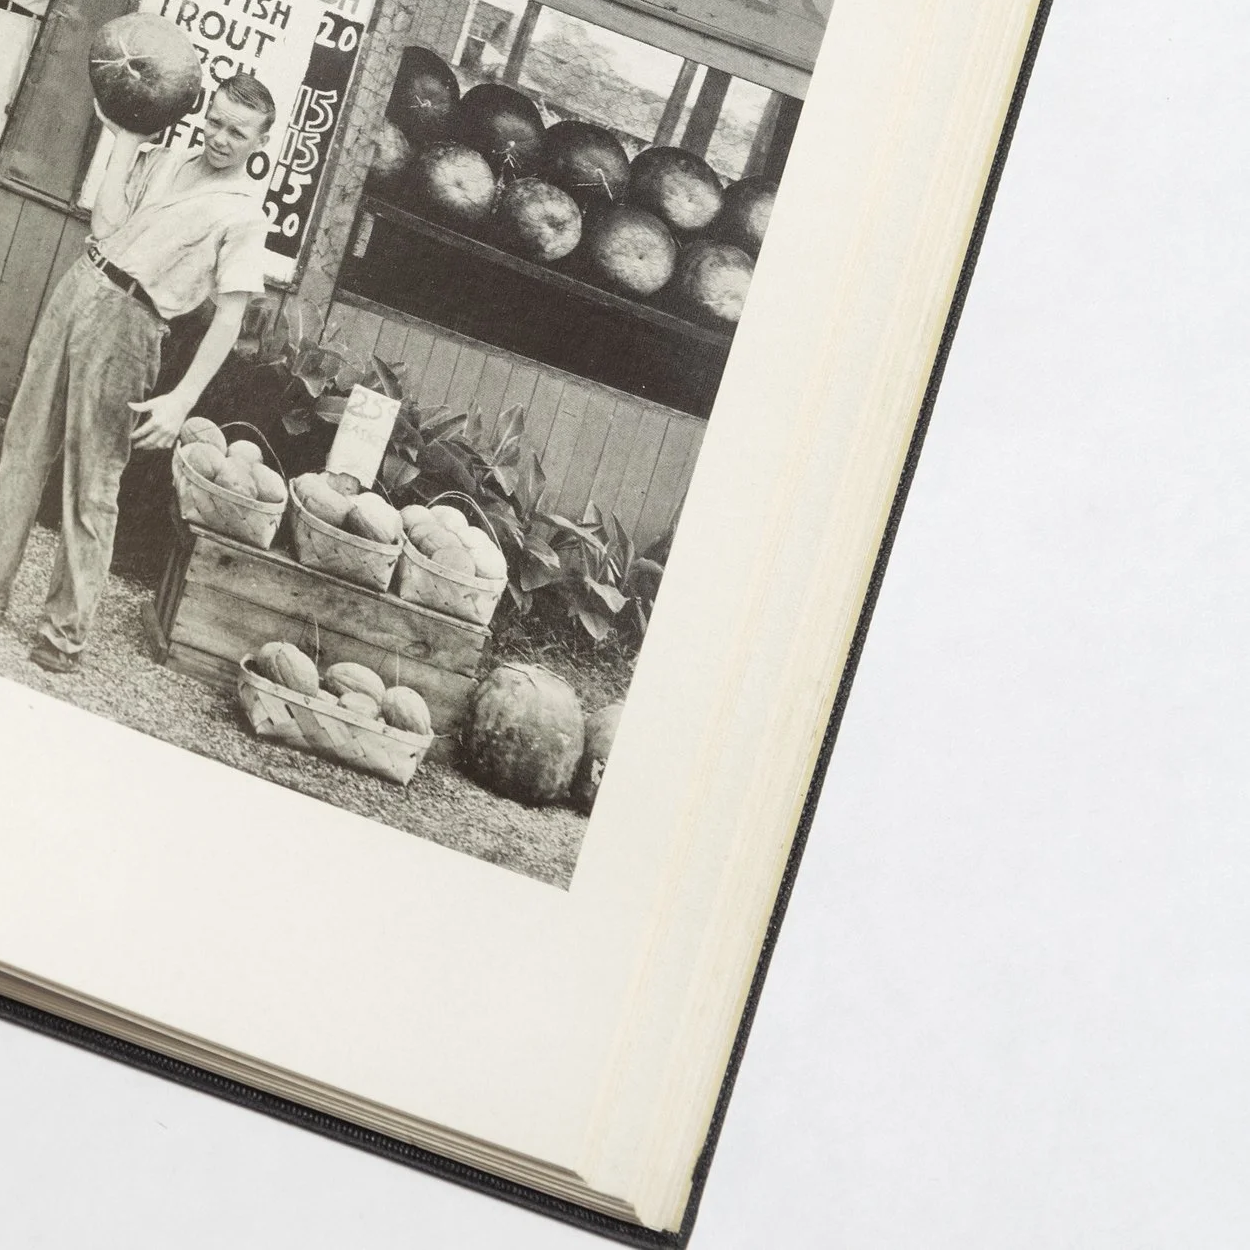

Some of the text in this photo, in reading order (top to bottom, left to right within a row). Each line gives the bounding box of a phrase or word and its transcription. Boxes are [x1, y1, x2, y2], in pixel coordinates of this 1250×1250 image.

[315, 16, 358, 52] 20
[289, 84, 338, 133] 15
[278, 126, 321, 173] 15
[269, 165, 313, 205] 15
